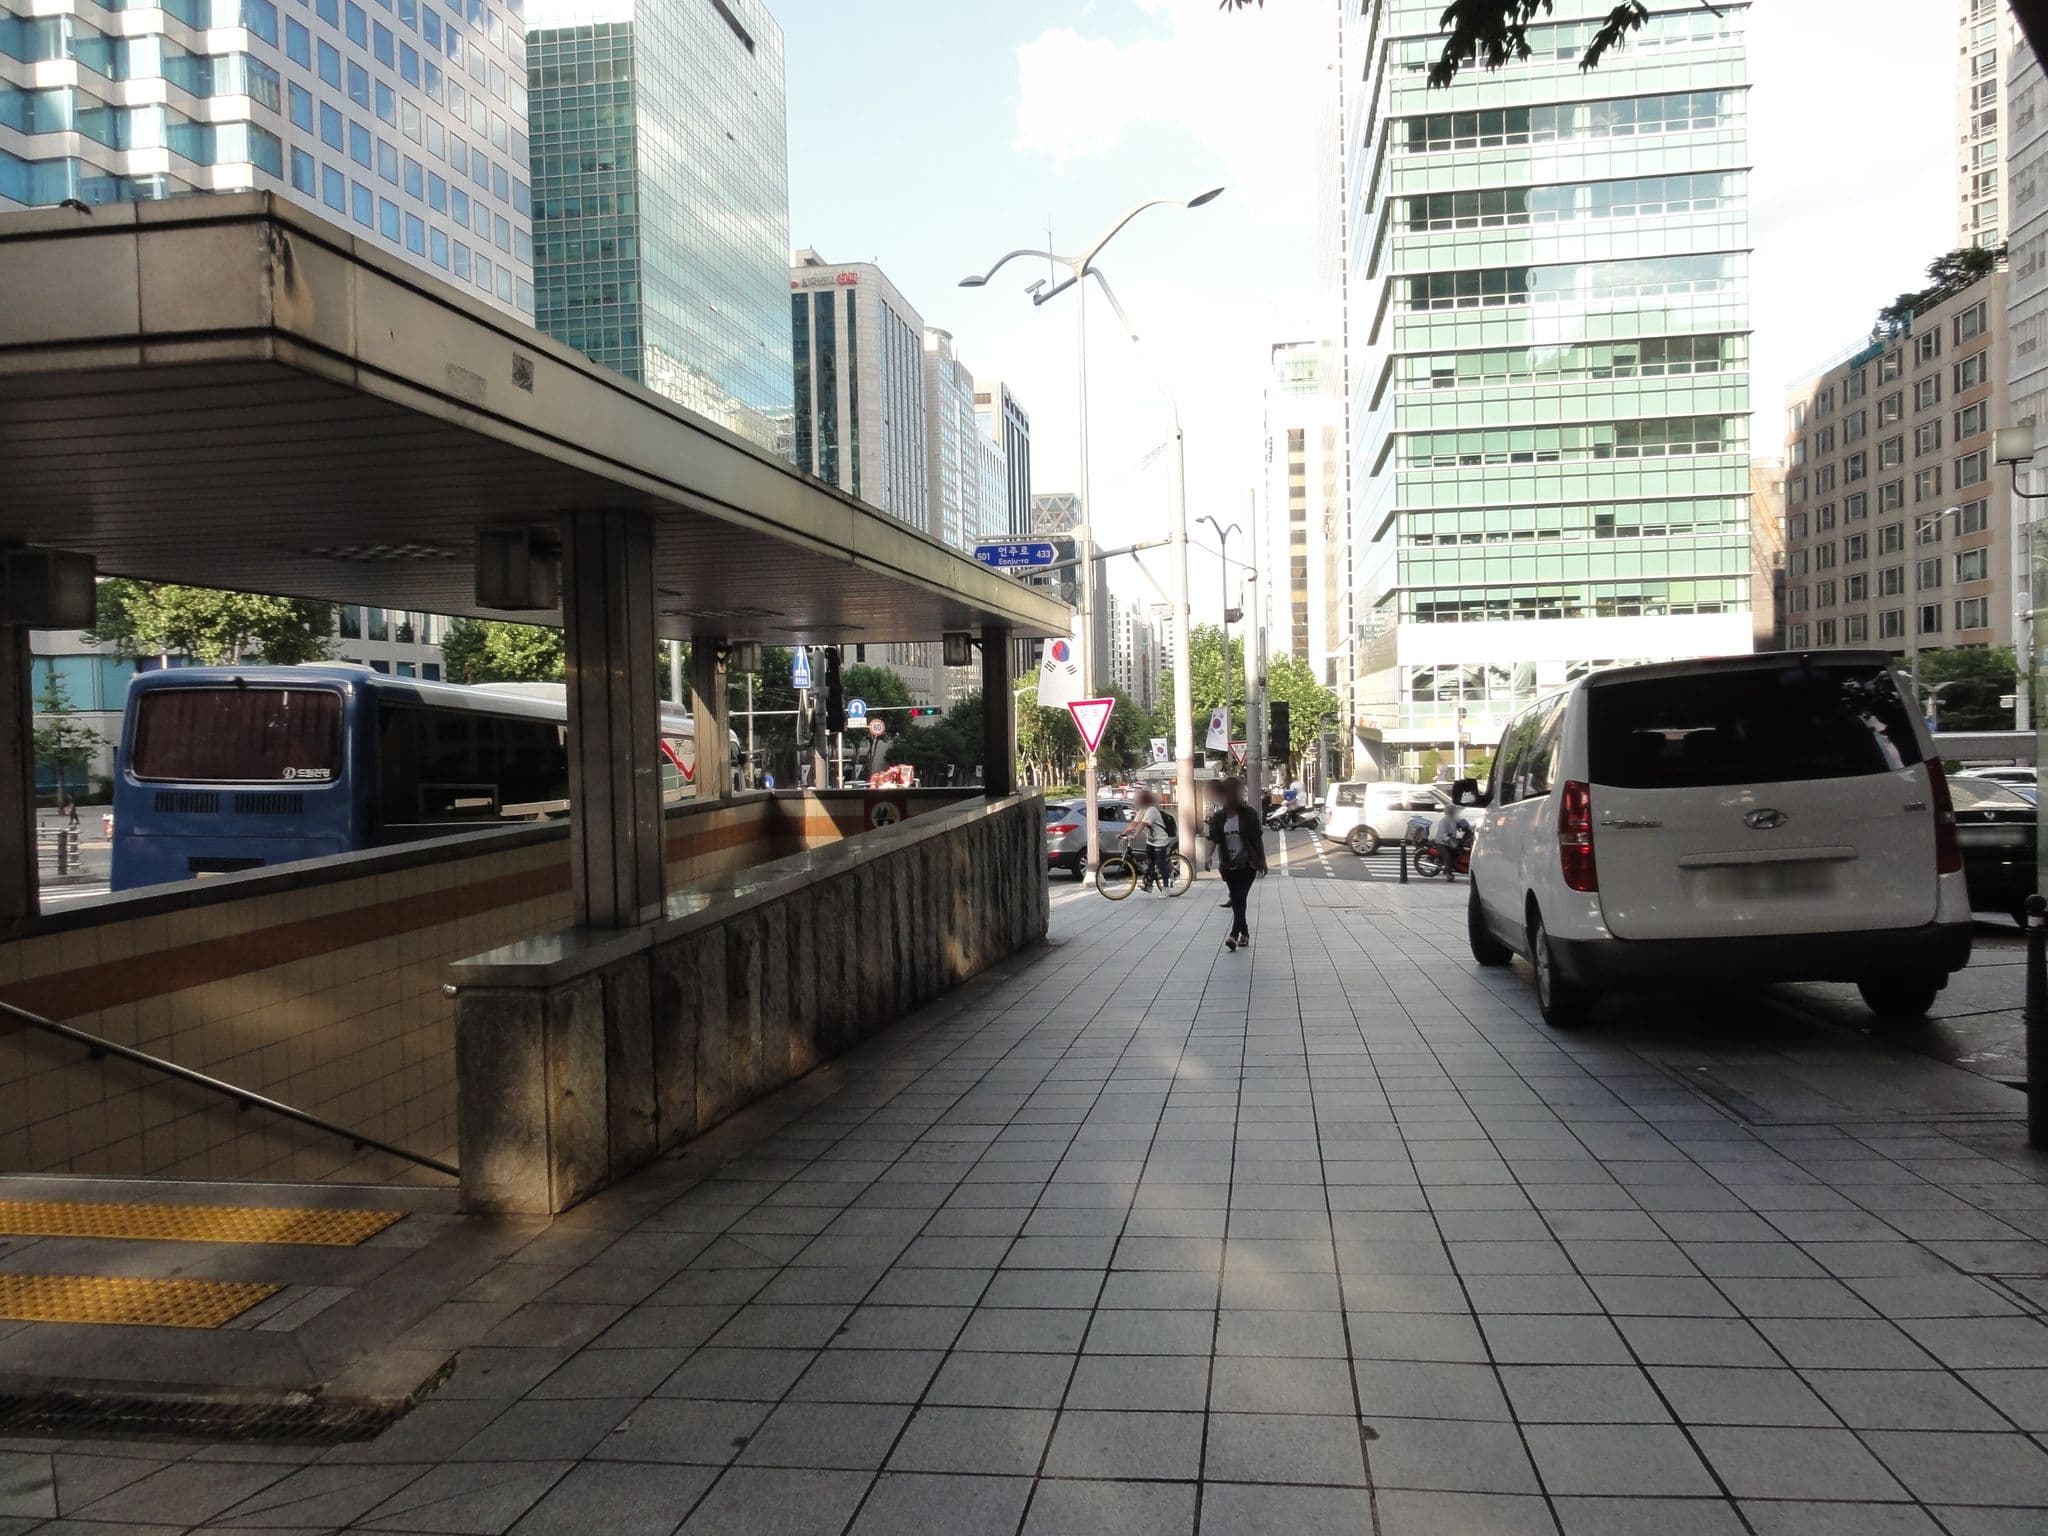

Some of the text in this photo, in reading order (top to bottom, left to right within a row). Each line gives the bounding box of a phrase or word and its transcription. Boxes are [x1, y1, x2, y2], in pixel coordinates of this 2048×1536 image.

[998, 546, 1029, 557] 언주로
[1035, 550, 1051, 559] 433
[977, 552, 991, 561] 501
[998, 558, 1029, 566] Eonju-ro
